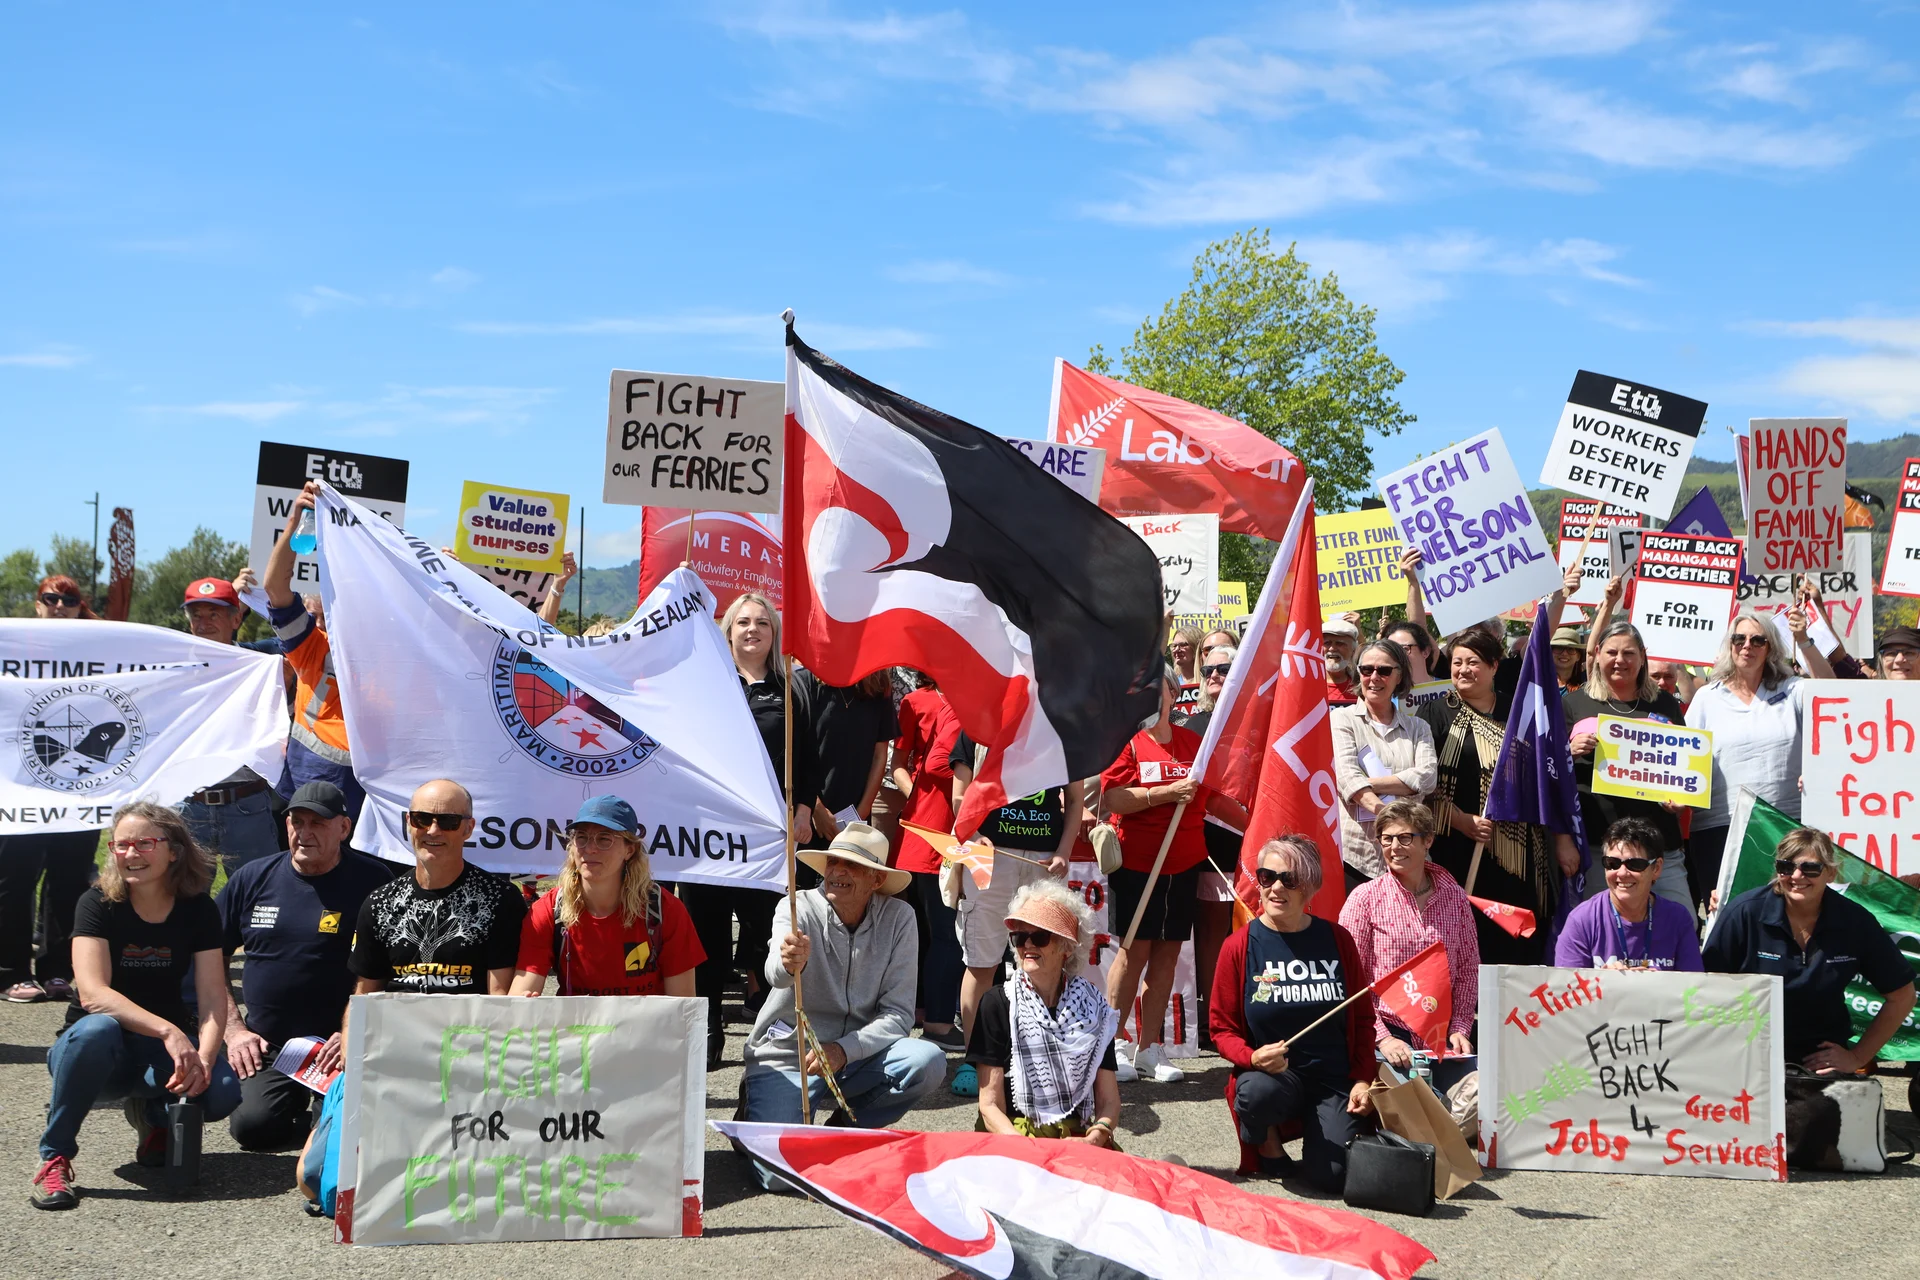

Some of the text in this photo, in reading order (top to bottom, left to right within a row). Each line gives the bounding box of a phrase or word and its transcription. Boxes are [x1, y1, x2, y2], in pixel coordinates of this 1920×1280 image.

[626, 378, 746, 419] FIGHT
[621, 420, 772, 455] BACK FOR
[1572, 413, 1681, 458] WORKERS
[1755, 427, 1847, 470] HANDS
[612, 454, 771, 496] OUR FERRIES
[1040, 446, 1089, 476] ARE
[1386, 439, 1490, 513] FIGHT
[1569, 439, 1667, 481] DESERVE
[1568, 465, 1650, 503] BETTER
[1767, 470, 1825, 506] OFF
[488, 495, 547, 517] Value
[1401, 496, 1464, 543] FOR
[1755, 505, 1837, 540] FAMILY
[471, 515, 556, 537] student
[473, 533, 549, 554] nurses
[1316, 530, 1360, 551] ETTER
[1409, 494, 1532, 571] NELSON
[1642, 551, 1737, 569] MARANGA AKE
[1645, 537, 1689, 552] FIGHT
[1695, 541, 1736, 556] BACK
[744, 568, 782, 588] Employe
[1421, 537, 1545, 606] HOSPITAL
[1643, 564, 1731, 585] TOGETHER
[1820, 572, 1858, 594] FOR
[517, 630, 554, 648] OF
[634, 591, 706, 637] ZEALAN
[1646, 613, 1714, 632] TE TIRITI
[1664, 602, 1699, 615] FOR
[495, 646, 548, 758] MARITIME
[21, 684, 142, 785] MARITIME UNION OF NEW ZEALAND
[1609, 723, 1701, 750] Support
[1811, 696, 1915, 764] Figh
[559, 757, 619, 774] 2002
[1629, 749, 1677, 766] paid
[66, 777, 104, 791] 2002
[1607, 764, 1698, 793] training
[1836, 773, 1915, 819] for
[998, 821, 1051, 836] Network
[1000, 807, 1050, 821] PSA Eco
[120, 959, 172, 967] icebreaker
[392, 962, 473, 976] TOGETHER
[1265, 959, 1339, 981] HOLY
[1273, 982, 1345, 1003] PUGAMOLE
[1399, 970, 1423, 1006] PSA
[1504, 971, 1603, 1036] Te Tiriti
[1682, 986, 1771, 1047] Equity
[1586, 1019, 1673, 1066] FIGHT
[439, 1024, 617, 1103] FIGHT
[1599, 1058, 1679, 1099] BACK
[1630, 1104, 1660, 1138] 4
[1685, 1088, 1754, 1124] Great
[451, 1110, 605, 1150] FOR OUR
[1545, 1118, 1631, 1162] Jobs
[404, 1153, 642, 1231] FUTURE
